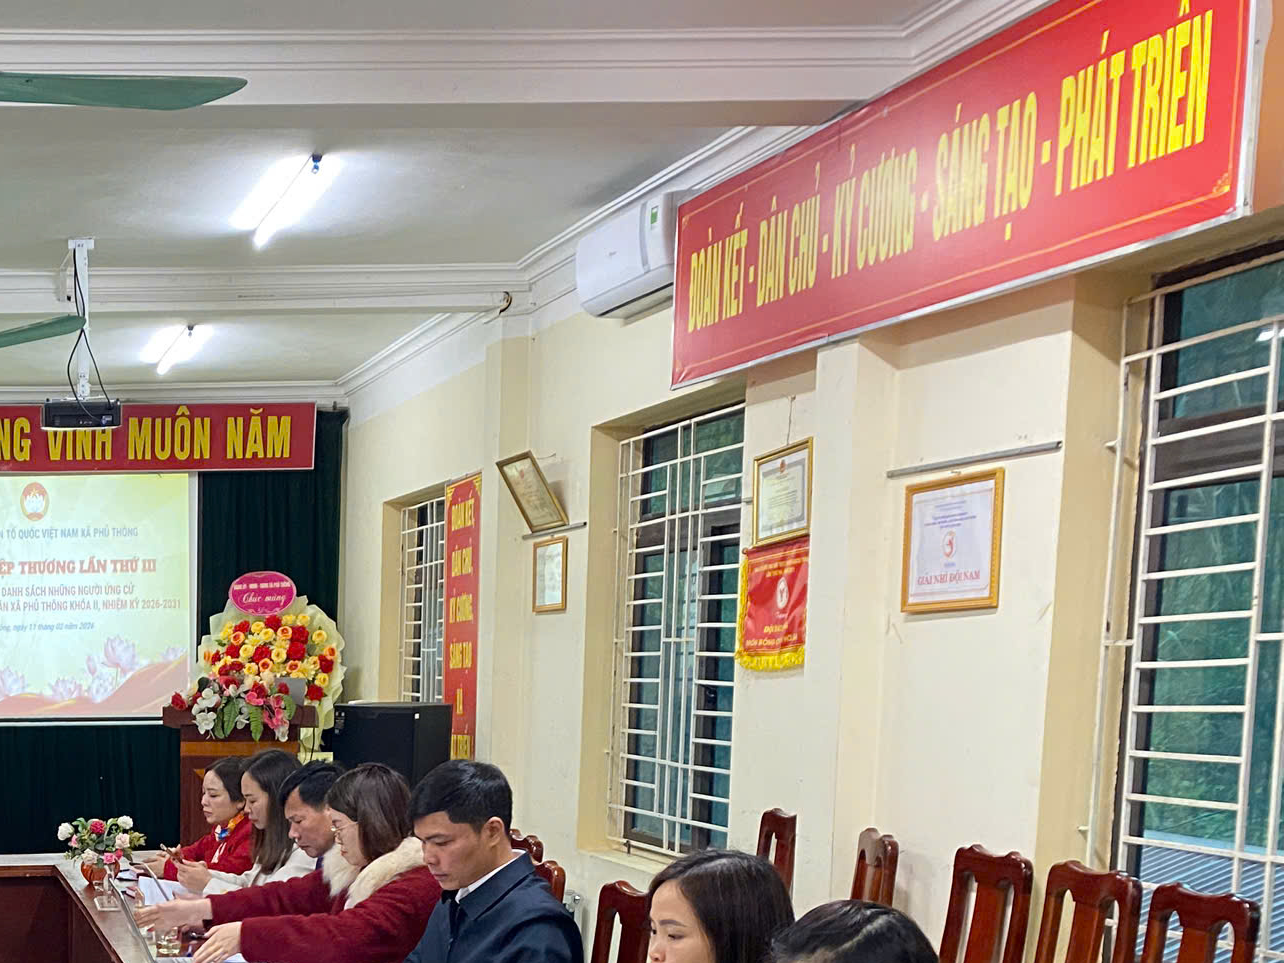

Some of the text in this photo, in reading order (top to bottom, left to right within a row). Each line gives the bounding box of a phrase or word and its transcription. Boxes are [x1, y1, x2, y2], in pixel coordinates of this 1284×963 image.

[688, 227, 722, 332] ĐOÀN
[722, 201, 748, 320] KẾT
[756, 196, 788, 307] DÂN
[788, 161, 821, 296] CHỦ
[831, 143, 856, 280] KỶ
[856, 147, 918, 271] CƯƠNG
[932, 102, 990, 242] SÁNG
[993, 91, 1037, 241] TẠO
[1055, 29, 1126, 196] PHÁT
[1127, 0, 1213, 169] TRIỂN
[47, 428, 112, 462] VINH
[128, 405, 210, 461] MUÔN
[226, 408, 291, 459] NĂM
[18, 526, 40, 539] QUỐC
[42, 527, 58, 540] VIỆT
[61, 528, 79, 538] NAM
[81, 526, 92, 538] XÃ
[111, 525, 138, 537] THÔNG
[18, 558, 75, 575] THƯƠNG
[110, 556, 140, 573] THỨ
[142, 558, 156, 572] III
[963, 569, 981, 581] NAM
[1, 586, 23, 597] DANH
[25, 584, 46, 597] SÁCH
[48, 583, 76, 596] NHỮNG
[78, 583, 103, 595] NGƯỜI
[10, 599, 22, 612] XÃ
[41, 599, 68, 612] THÔNG
[69, 599, 92, 611] KHÓA
[102, 598, 128, 611] NHIỆM
[141, 599, 181, 609] 2026-2031
